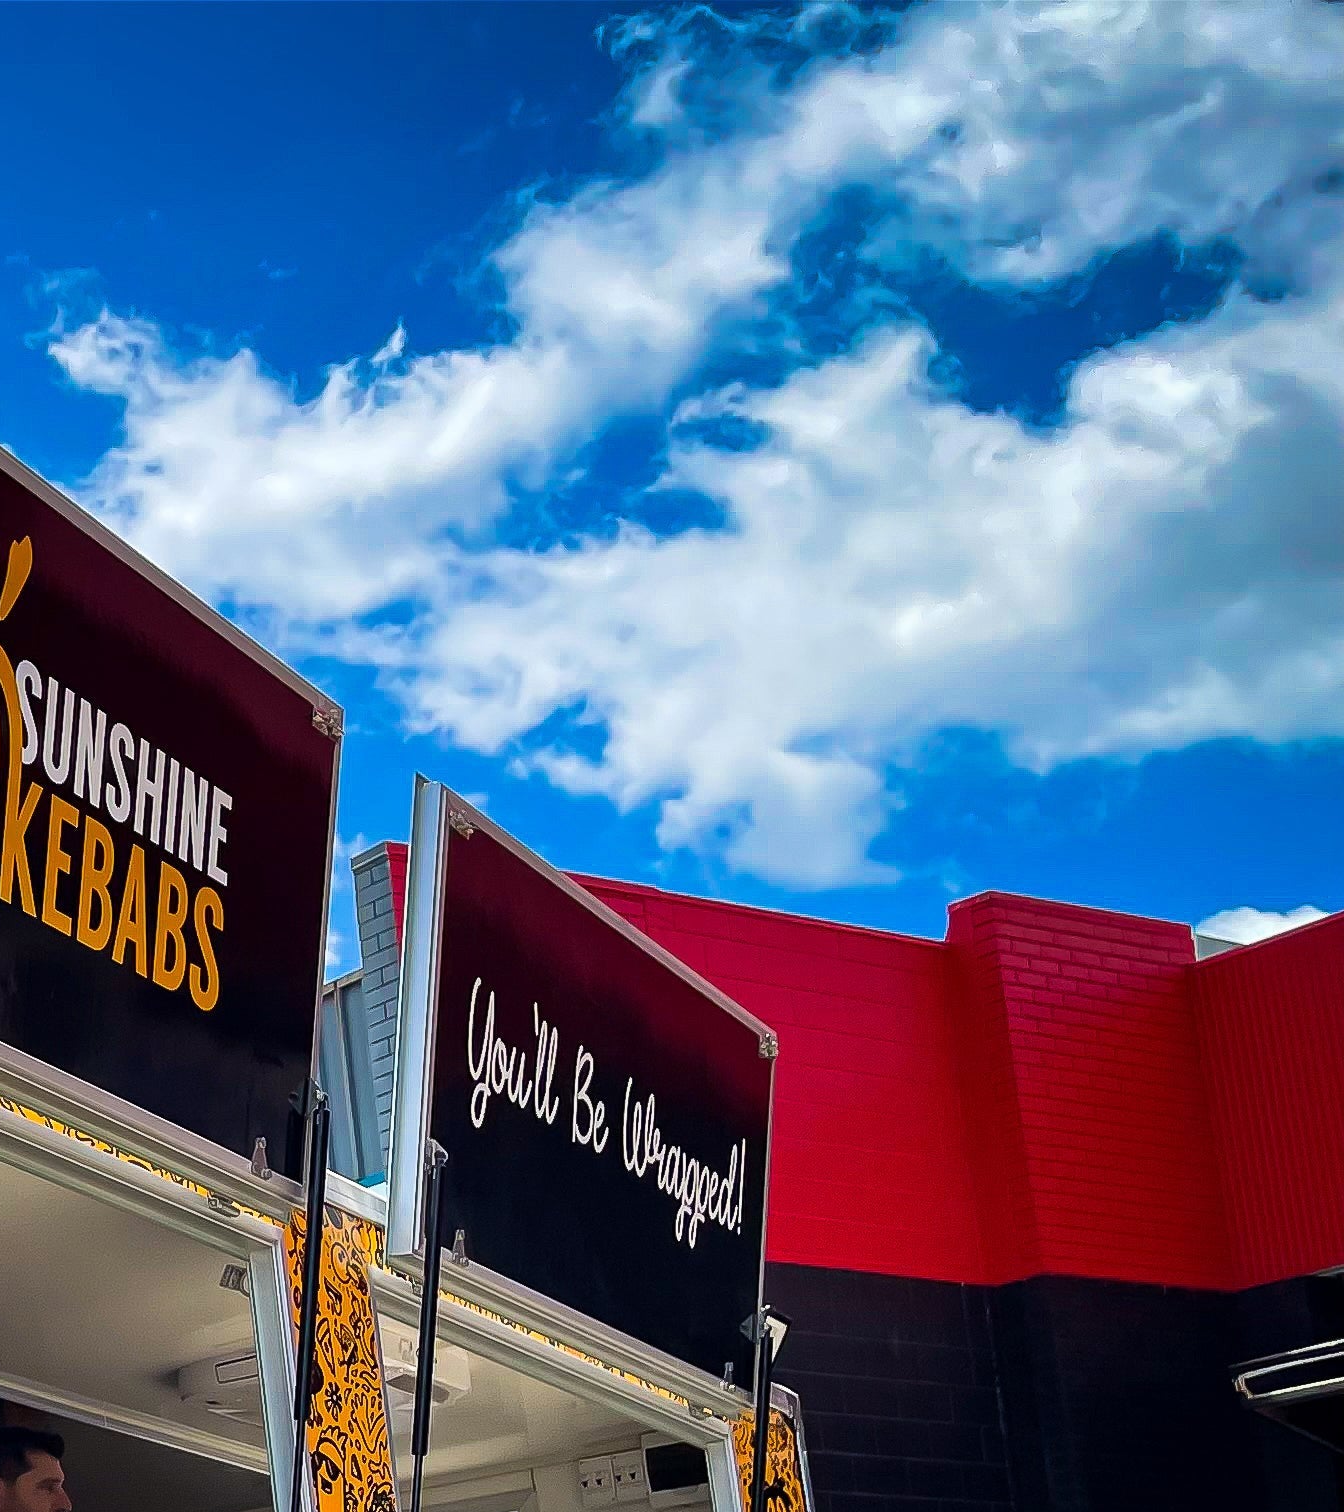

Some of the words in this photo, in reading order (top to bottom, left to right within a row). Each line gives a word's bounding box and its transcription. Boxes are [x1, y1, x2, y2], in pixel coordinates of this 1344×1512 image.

[15, 659, 232, 886] SUNSHINE
[468, 977, 559, 1128] You'll
[572, 1045, 609, 1154] Be
[623, 1077, 746, 1249] Wrapped!
